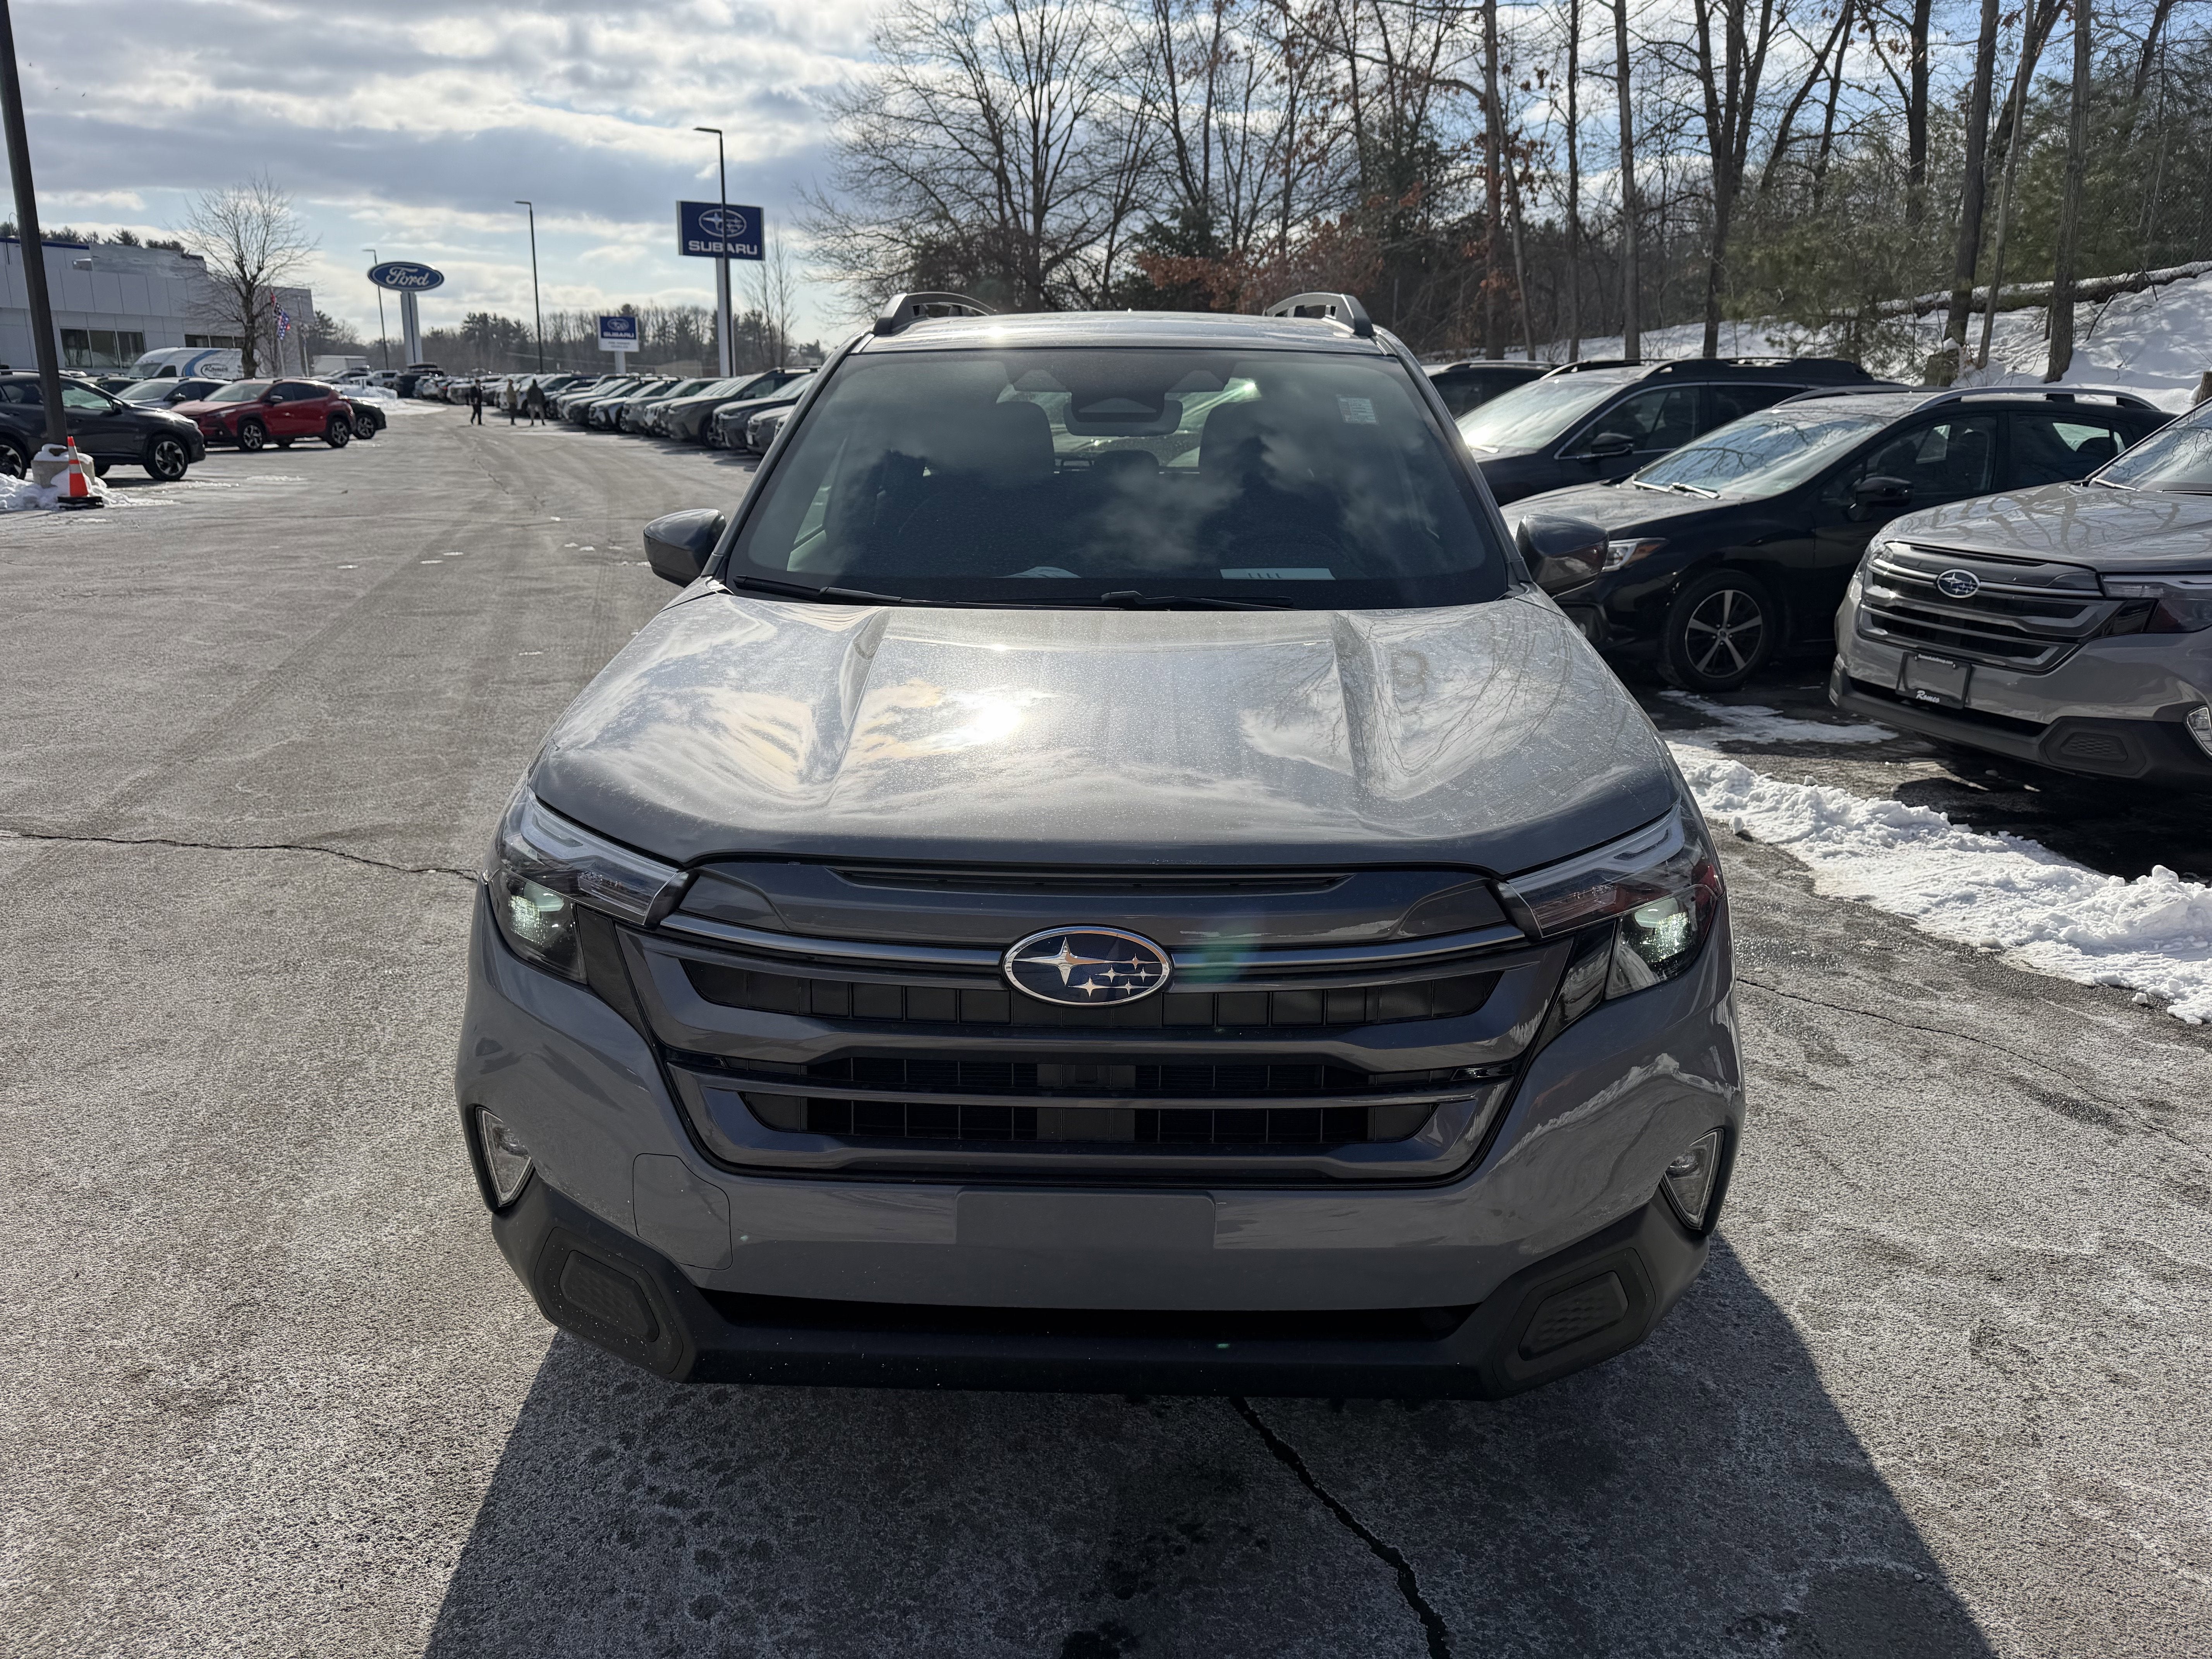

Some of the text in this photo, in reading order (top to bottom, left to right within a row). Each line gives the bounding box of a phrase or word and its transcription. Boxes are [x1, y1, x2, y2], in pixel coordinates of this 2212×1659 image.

[688, 240, 757, 255] SUBARU
[386, 266, 429, 286] Ford
[1915, 690, 1940, 703] Romeo
